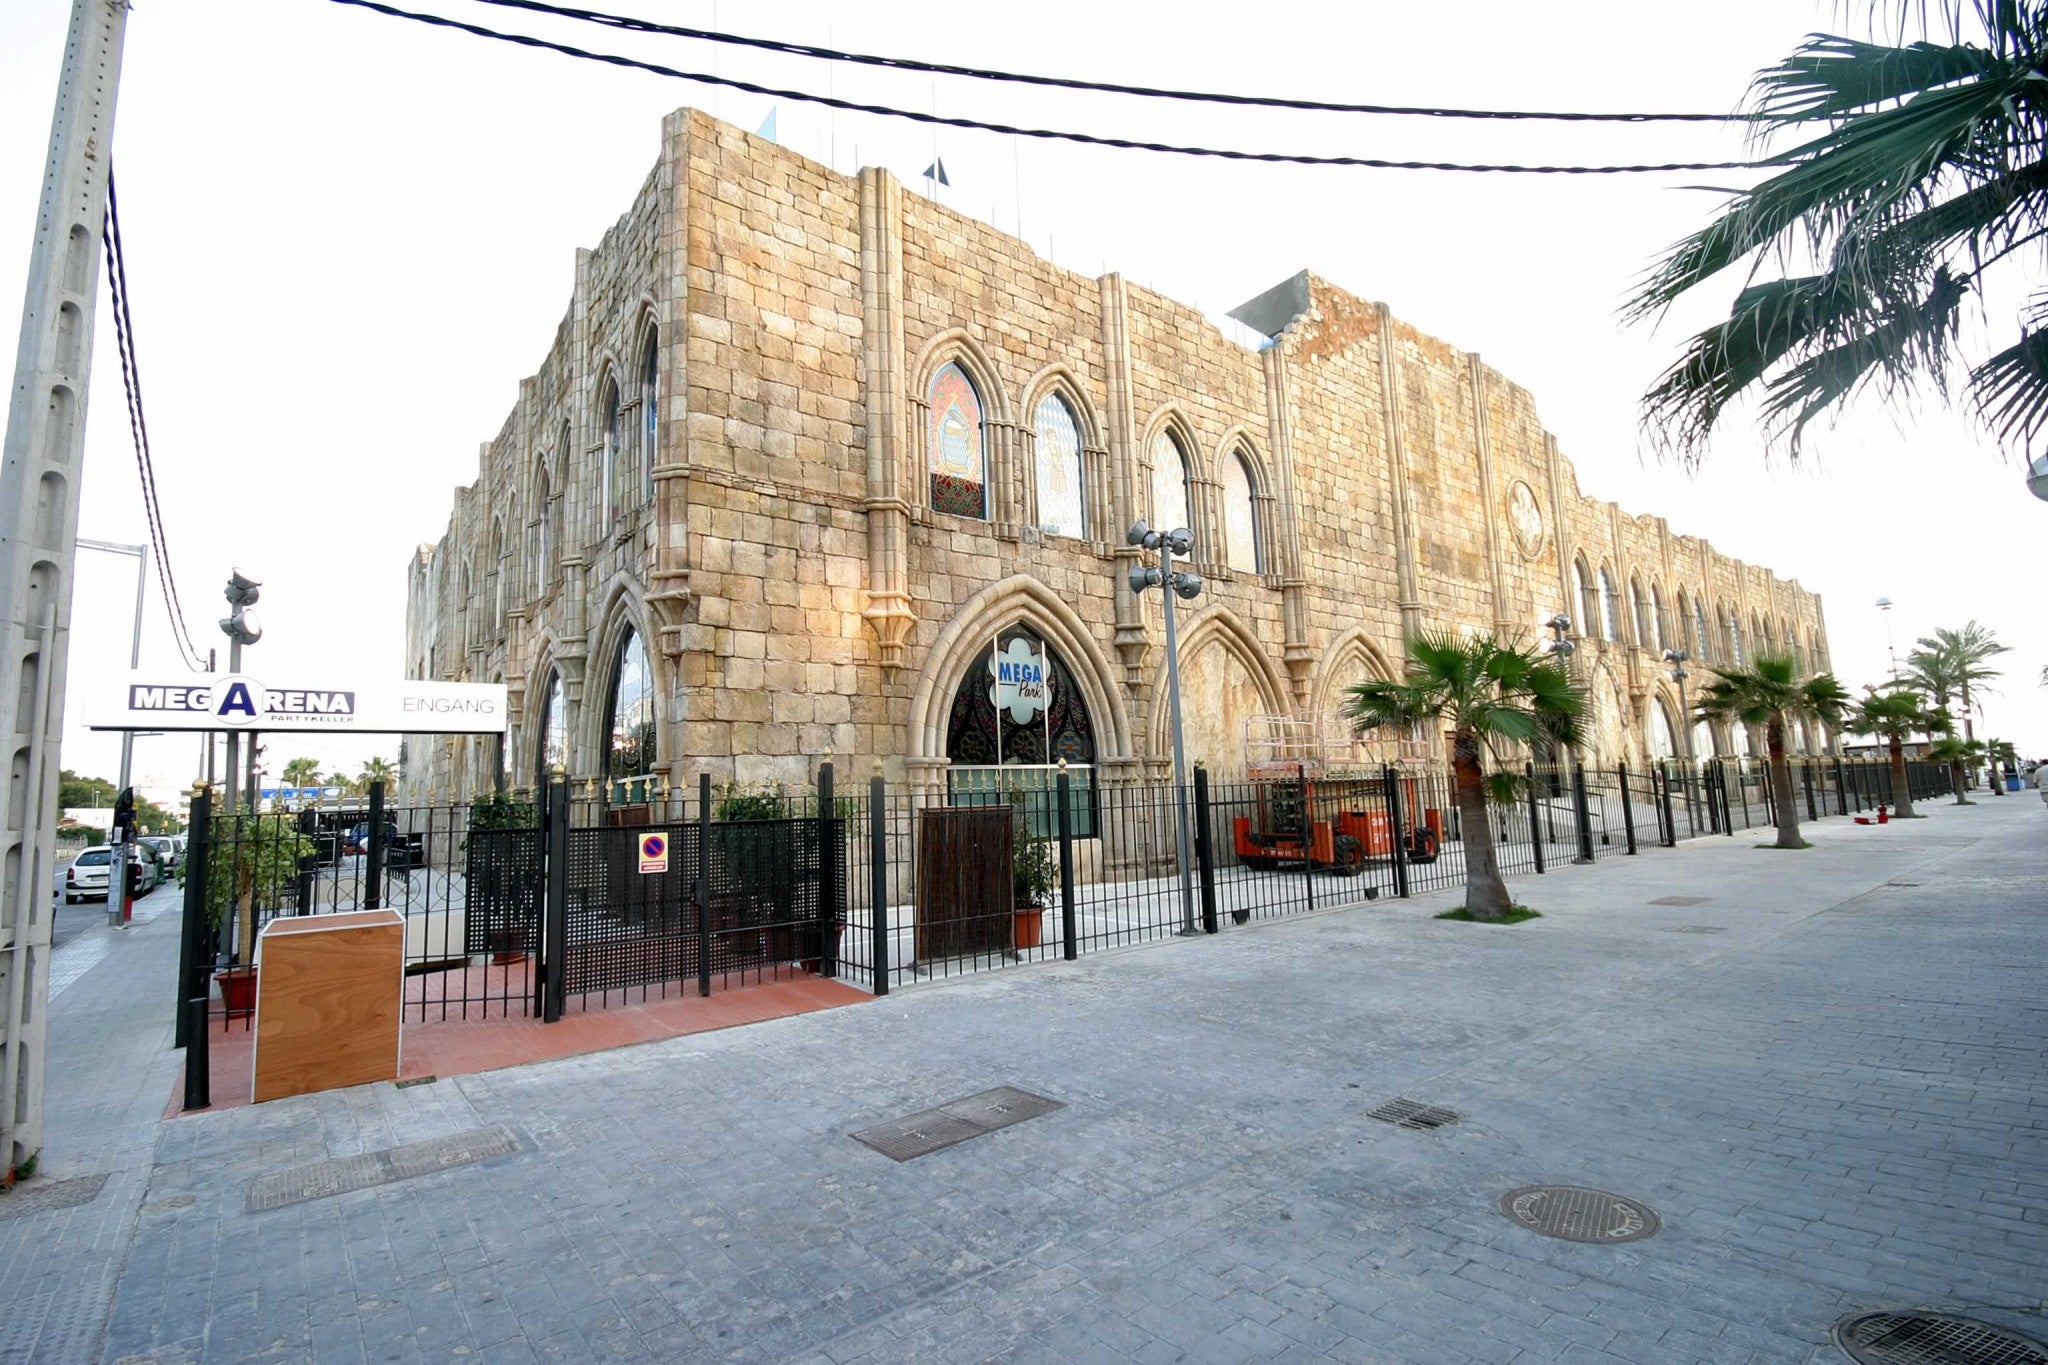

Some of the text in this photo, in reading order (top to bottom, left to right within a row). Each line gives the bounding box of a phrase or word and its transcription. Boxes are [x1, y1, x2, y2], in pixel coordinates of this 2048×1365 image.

[999, 662, 1041, 682] MEGA
[1018, 679, 1041, 698] Park
[403, 697, 494, 714] EINGANG
[271, 715, 354, 723] PARTYKELLER
